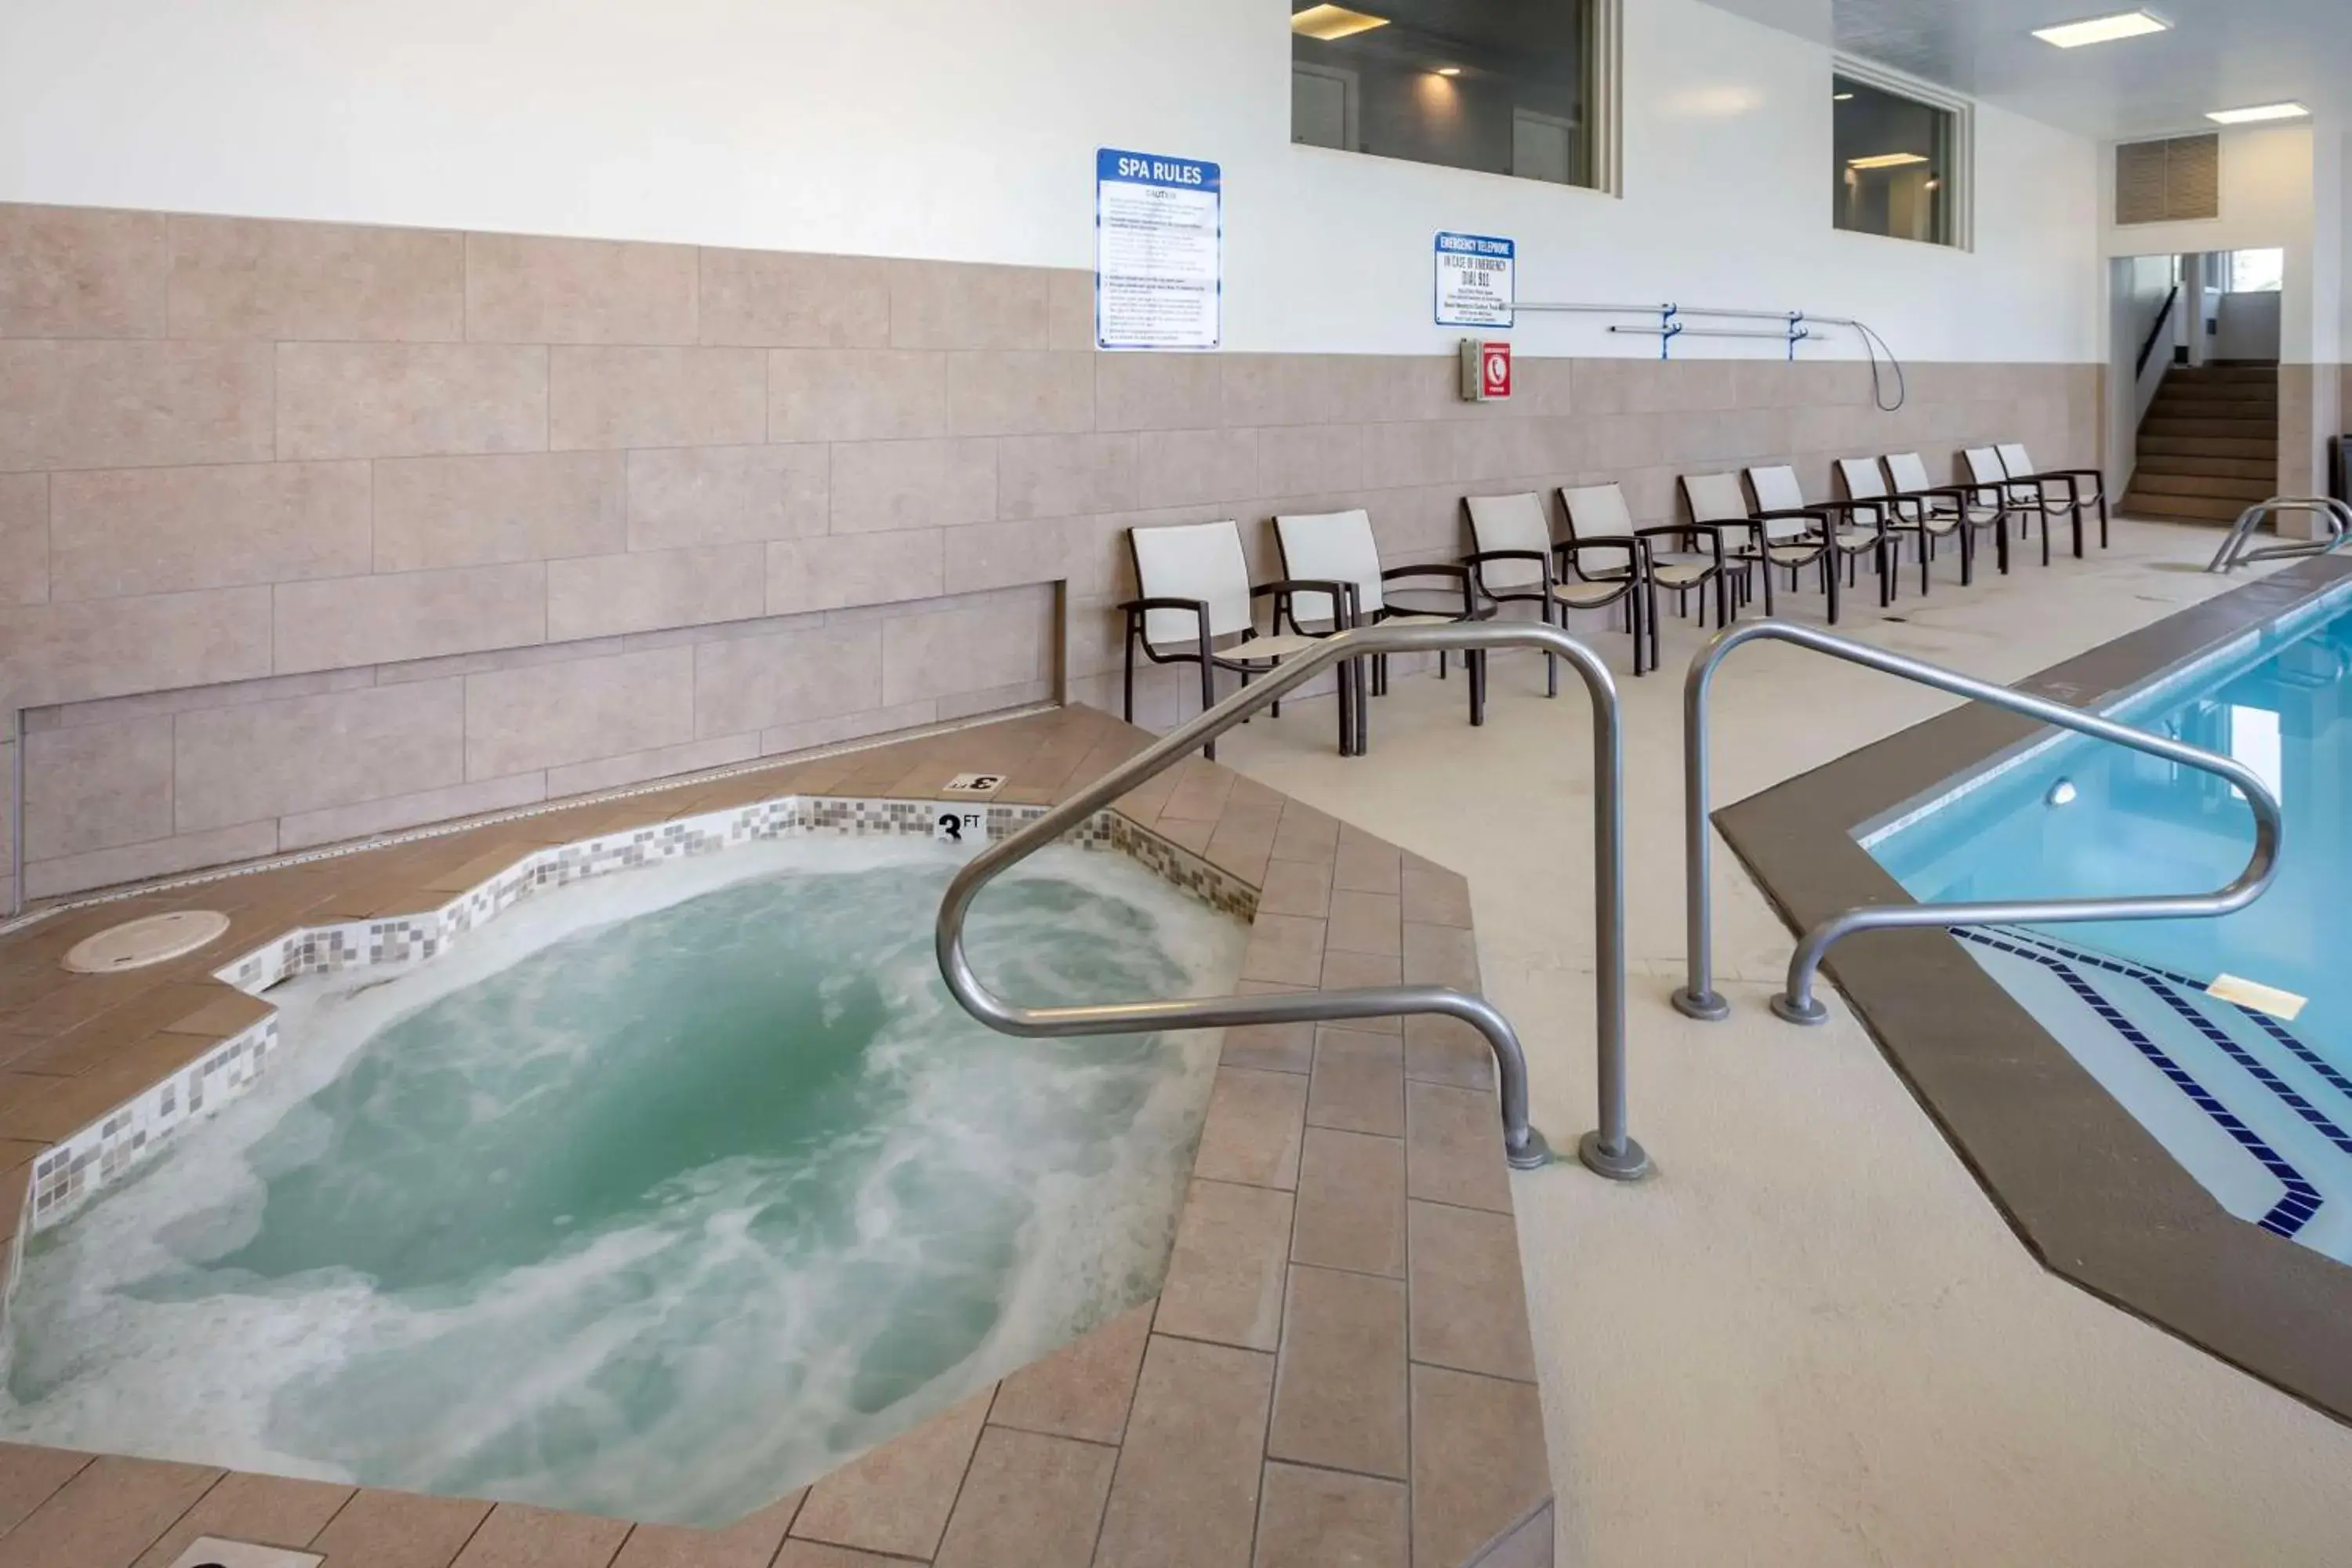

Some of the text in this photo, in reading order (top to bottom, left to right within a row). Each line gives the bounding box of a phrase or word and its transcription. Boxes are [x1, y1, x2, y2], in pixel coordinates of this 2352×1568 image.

[1119, 158, 1202, 184] SPA RULES
[970, 777, 997, 789] 3
[938, 813, 980, 840] 3 FT
